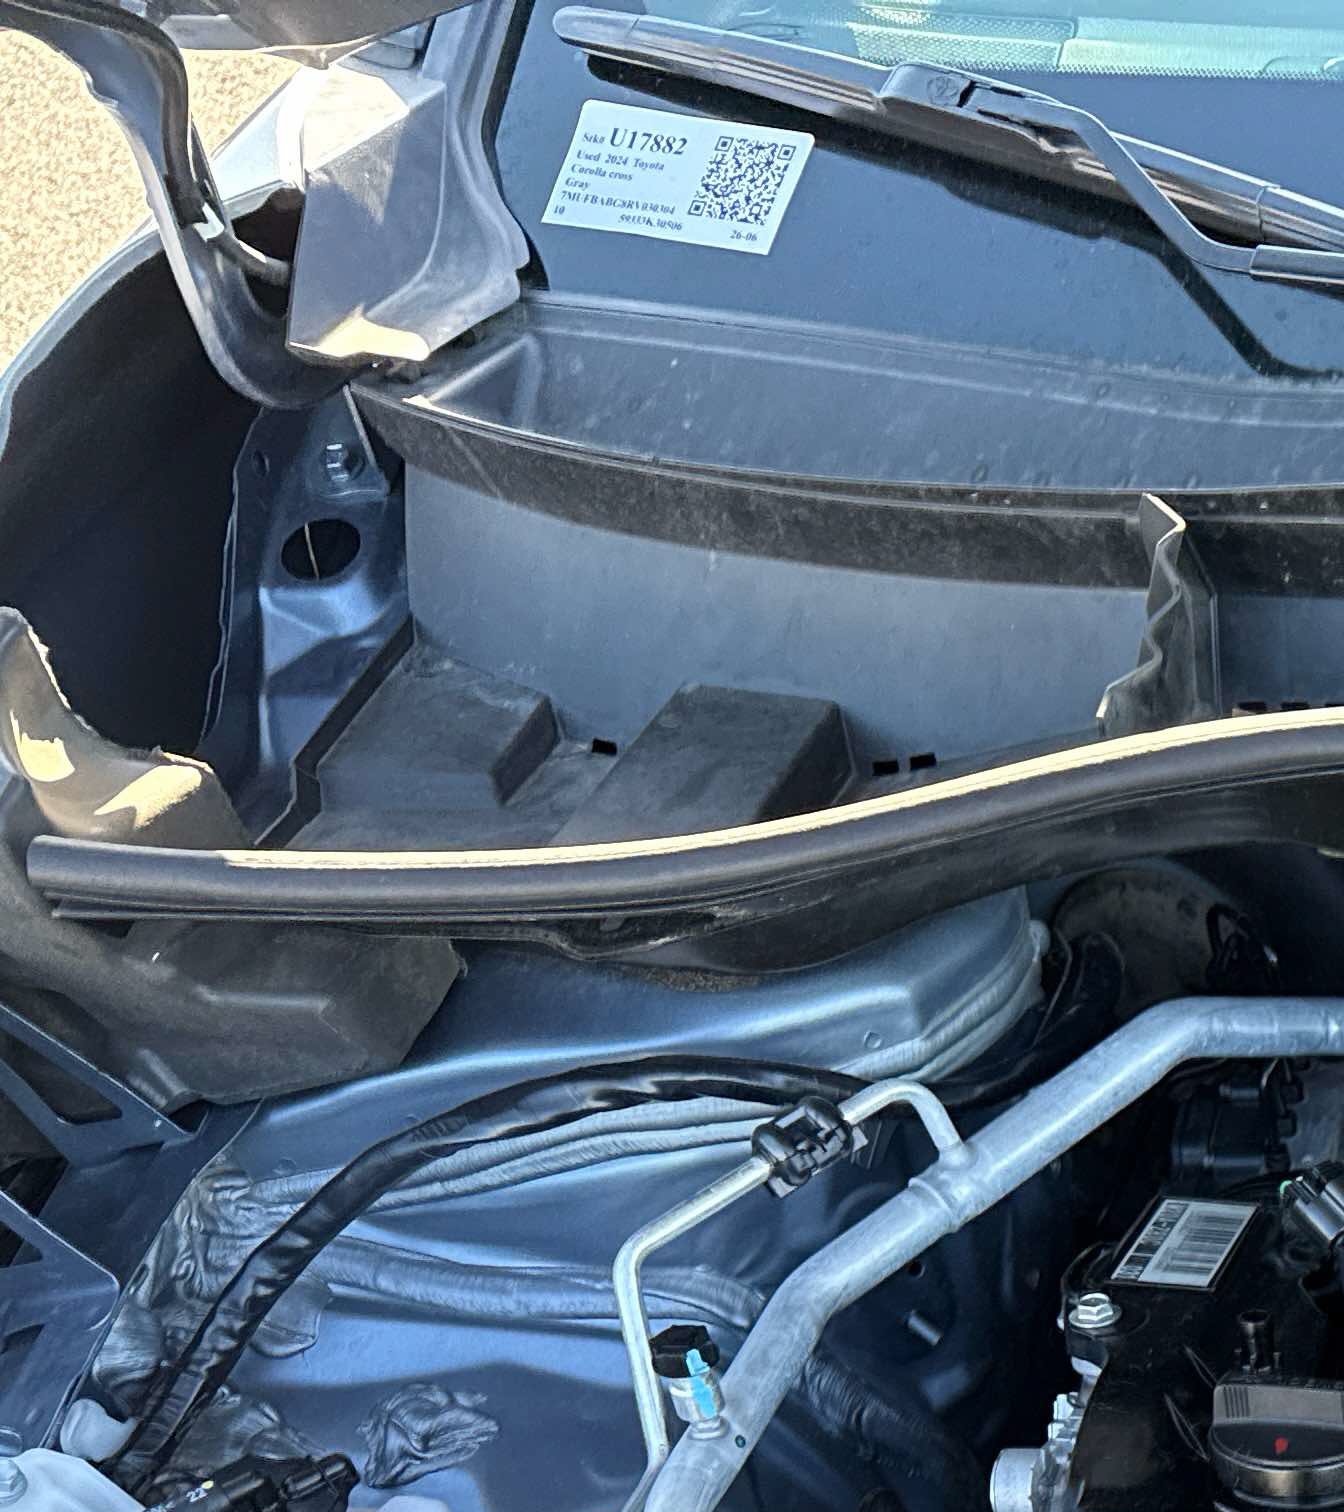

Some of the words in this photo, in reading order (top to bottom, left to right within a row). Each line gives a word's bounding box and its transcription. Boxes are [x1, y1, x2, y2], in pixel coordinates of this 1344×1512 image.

[609, 128, 688, 155] U17882
[576, 149, 602, 162] Used
[604, 153, 629, 166] 2024
[633, 158, 665, 171] Toyota
[571, 163, 606, 177] Corolla
[608, 171, 633, 181] cross
[565, 177, 590, 191] Gray
[729, 229, 758, 242] 26-06
